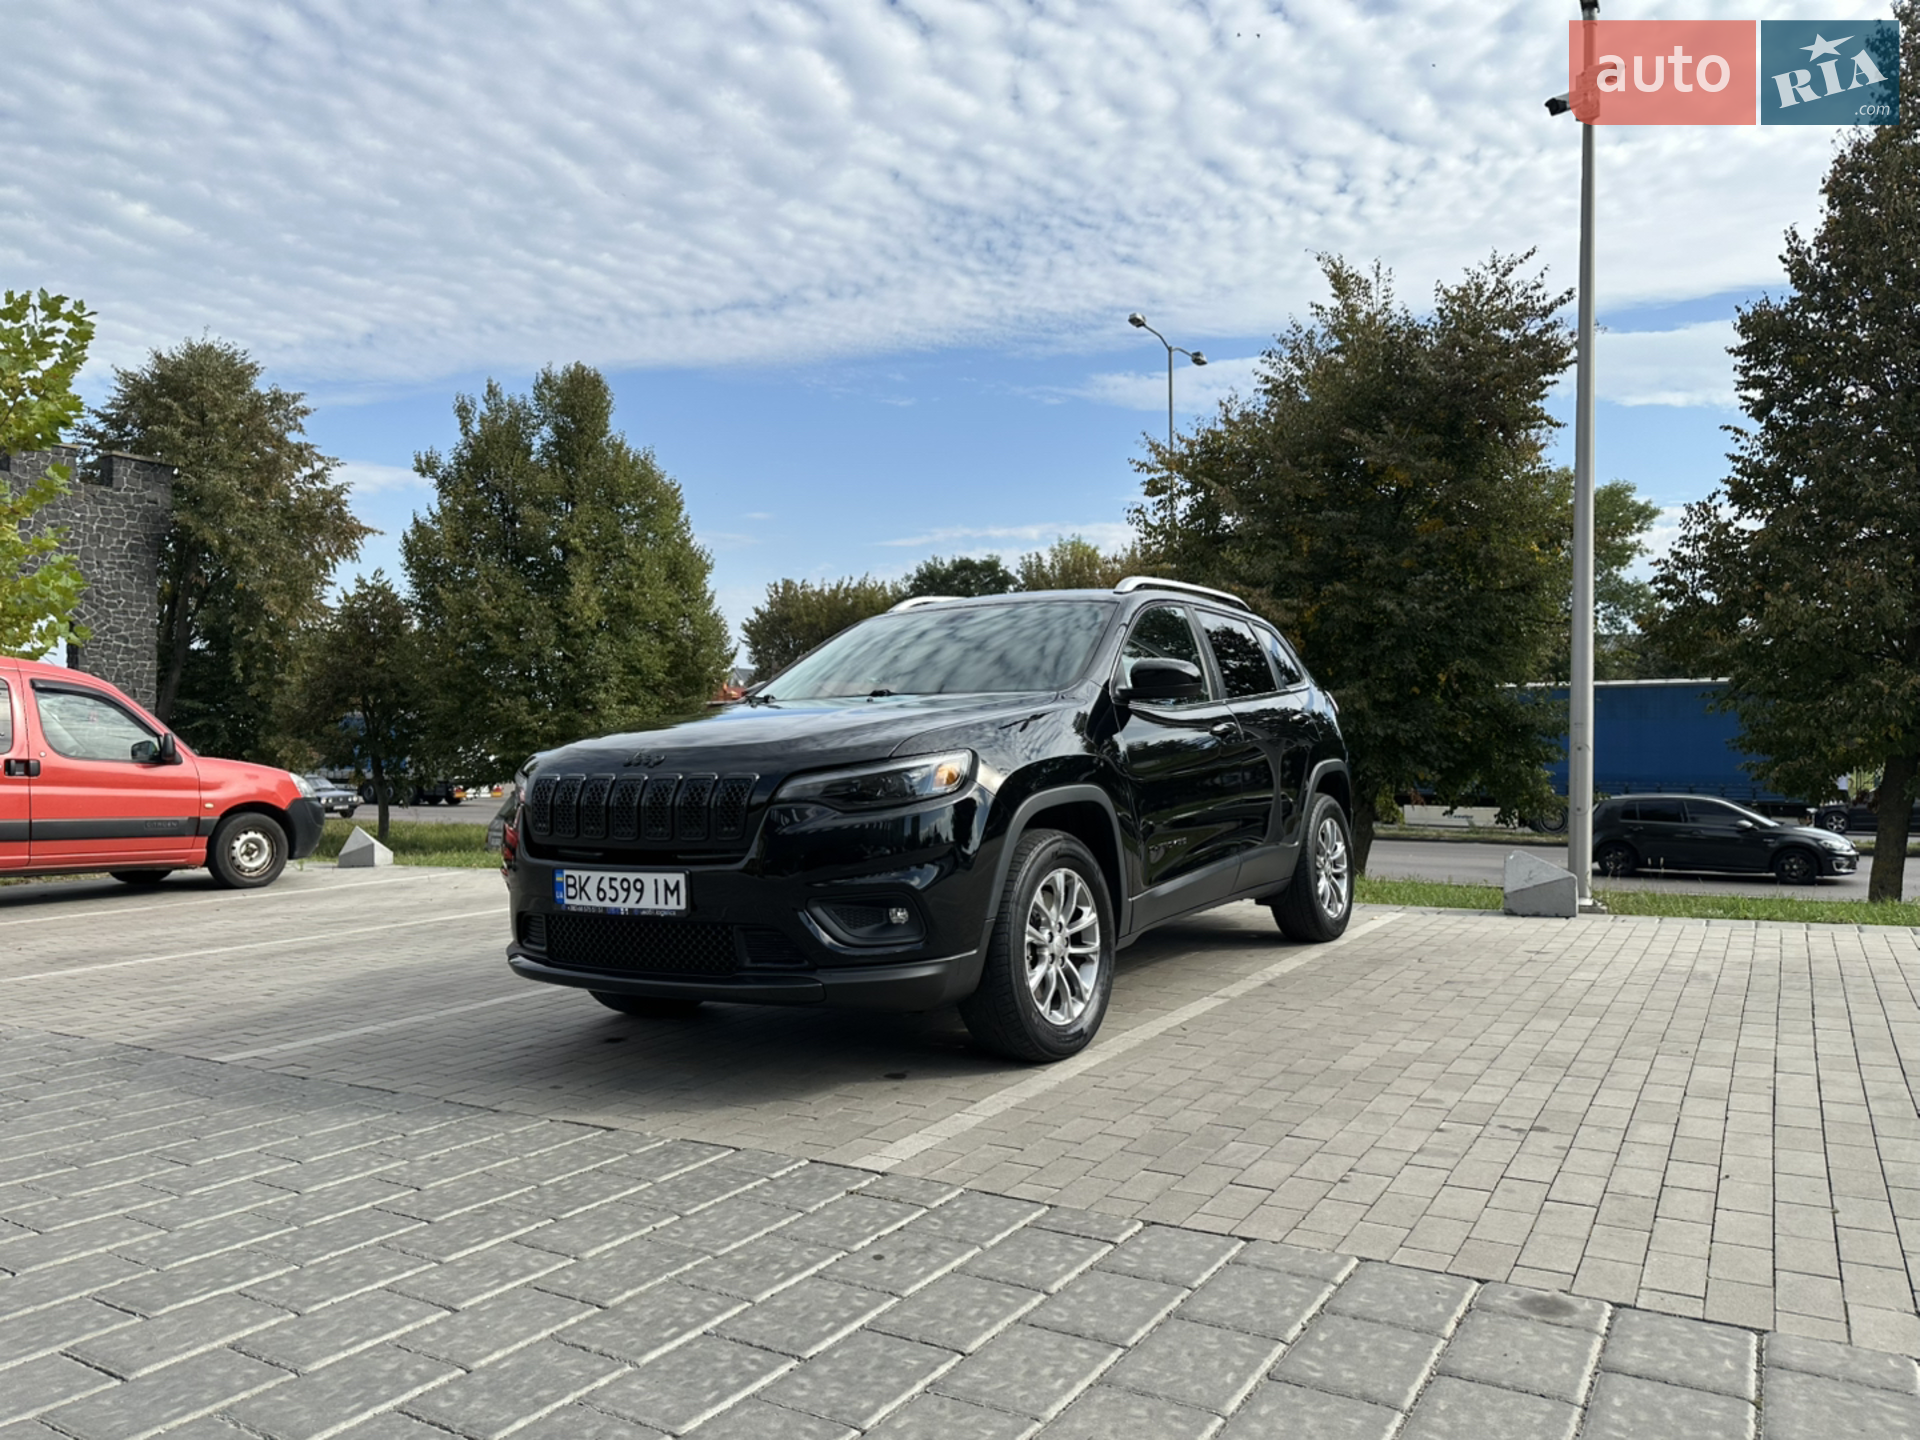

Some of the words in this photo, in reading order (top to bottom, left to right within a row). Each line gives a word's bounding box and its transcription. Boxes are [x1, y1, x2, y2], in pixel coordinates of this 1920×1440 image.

[565, 874, 592, 902] BK
[596, 876, 645, 905] 6599
[654, 878, 681, 906] IM
